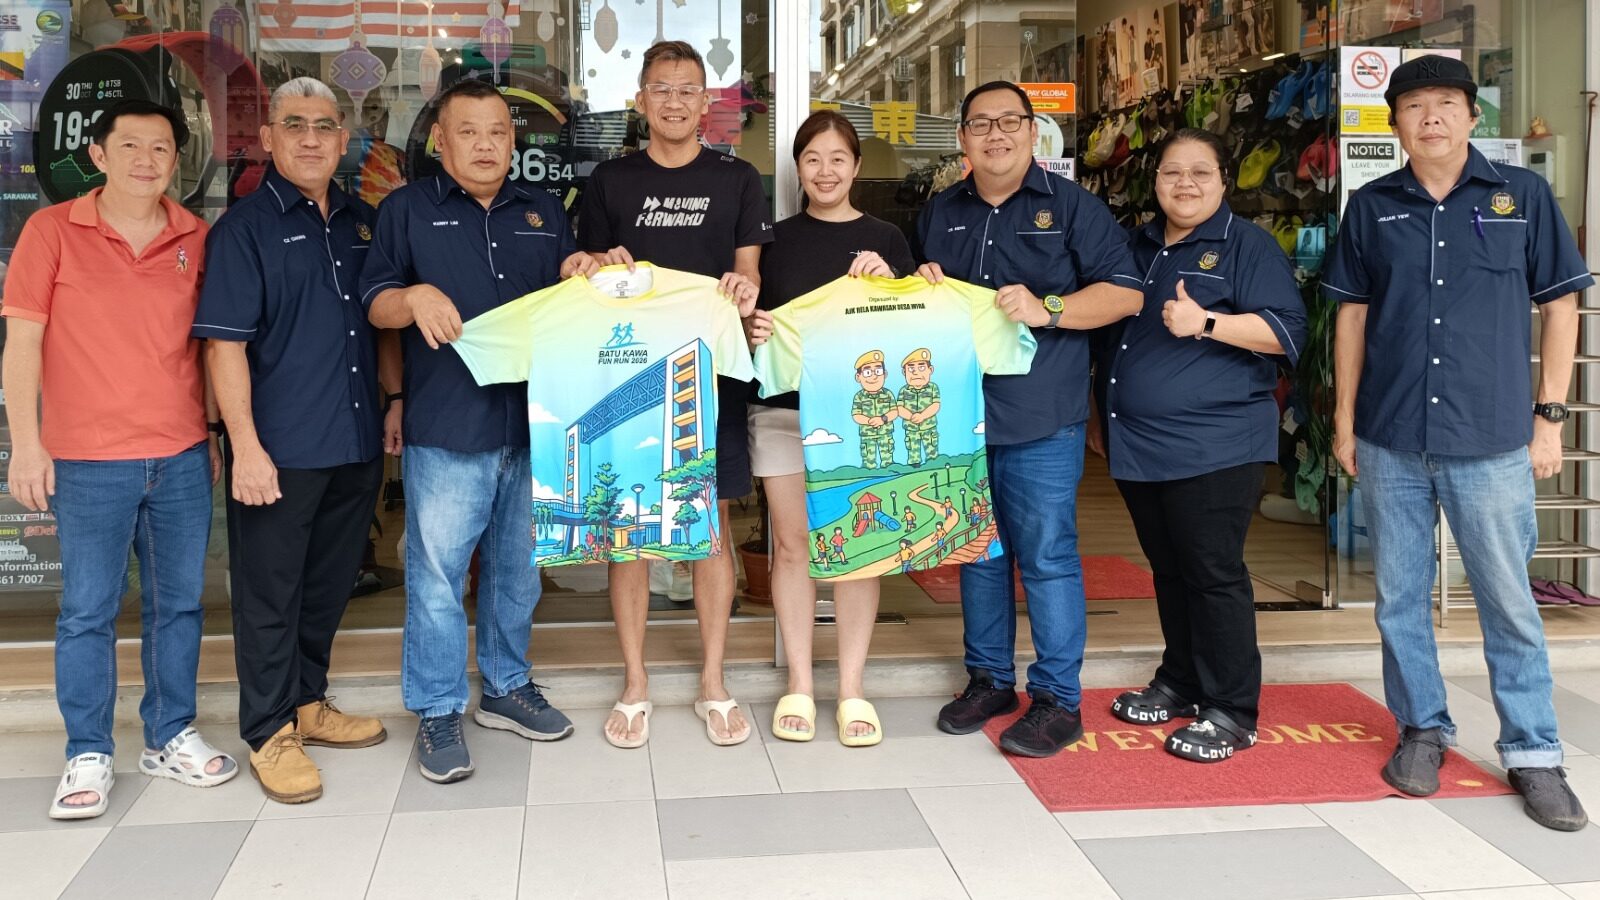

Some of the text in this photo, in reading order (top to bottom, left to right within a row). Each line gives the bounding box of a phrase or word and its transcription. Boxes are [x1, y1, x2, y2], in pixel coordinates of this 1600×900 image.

[66, 83, 80, 100] 30
[1041, 89, 1068, 98] GLOBAL
[1349, 146, 1392, 156] NOTICE
[1049, 162, 1071, 171] TOLAK
[548, 163, 575, 182] 54
[3, 193, 38, 201] SARAWAK
[663, 197, 711, 211] MOVING
[635, 211, 705, 227] FORWARD
[599, 349, 648, 358] BATU KAWA
[613, 357, 630, 365] RUN
[18, 574, 45, 584] 7007
